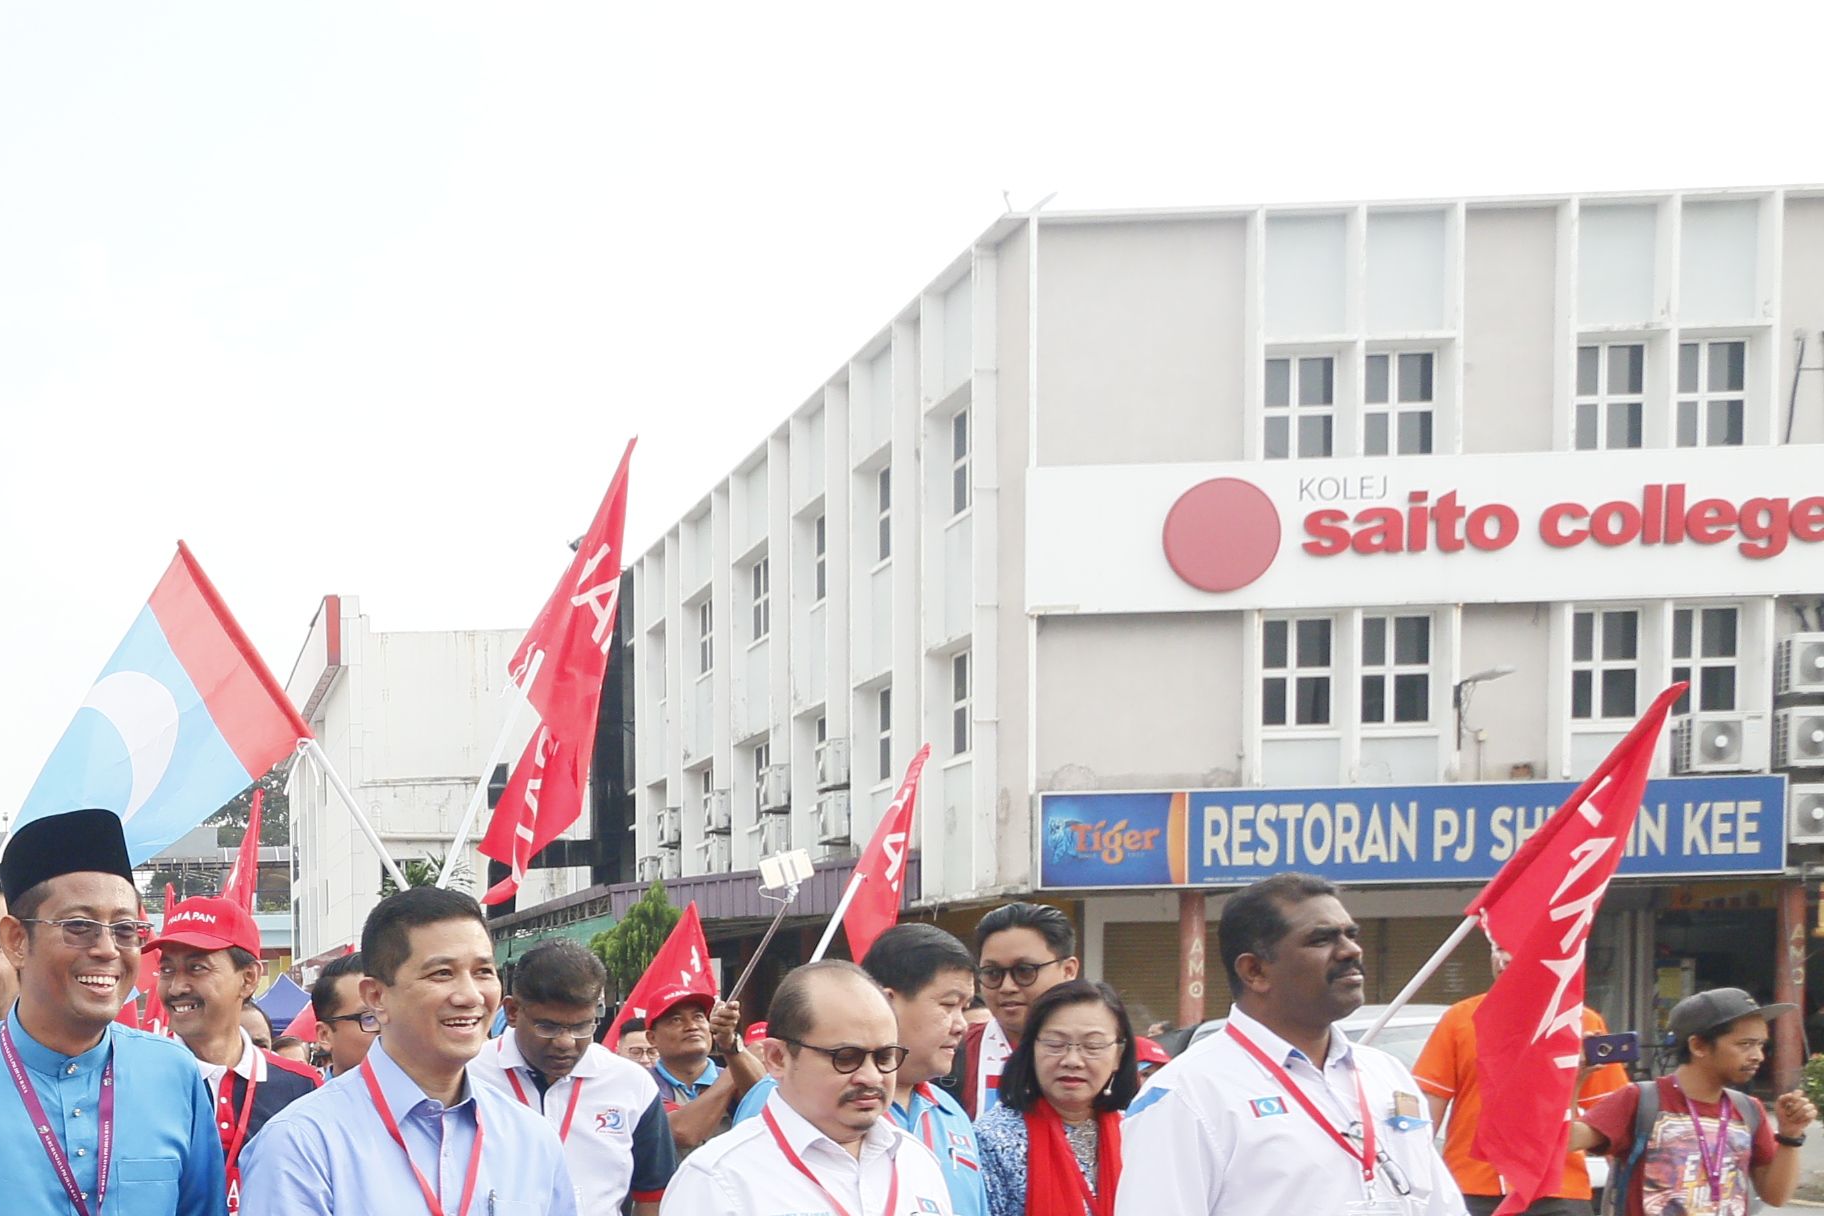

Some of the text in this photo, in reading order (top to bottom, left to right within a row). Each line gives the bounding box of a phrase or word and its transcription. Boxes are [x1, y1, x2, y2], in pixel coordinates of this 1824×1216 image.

[1298, 475, 1388, 502] KOLEJ
[1301, 483, 1824, 560] saito college
[1071, 819, 1160, 865] Tiger
[1203, 801, 1419, 867] RESTORAN
[1433, 807, 1476, 863] PJ
[1682, 800, 1762, 856] KEE
